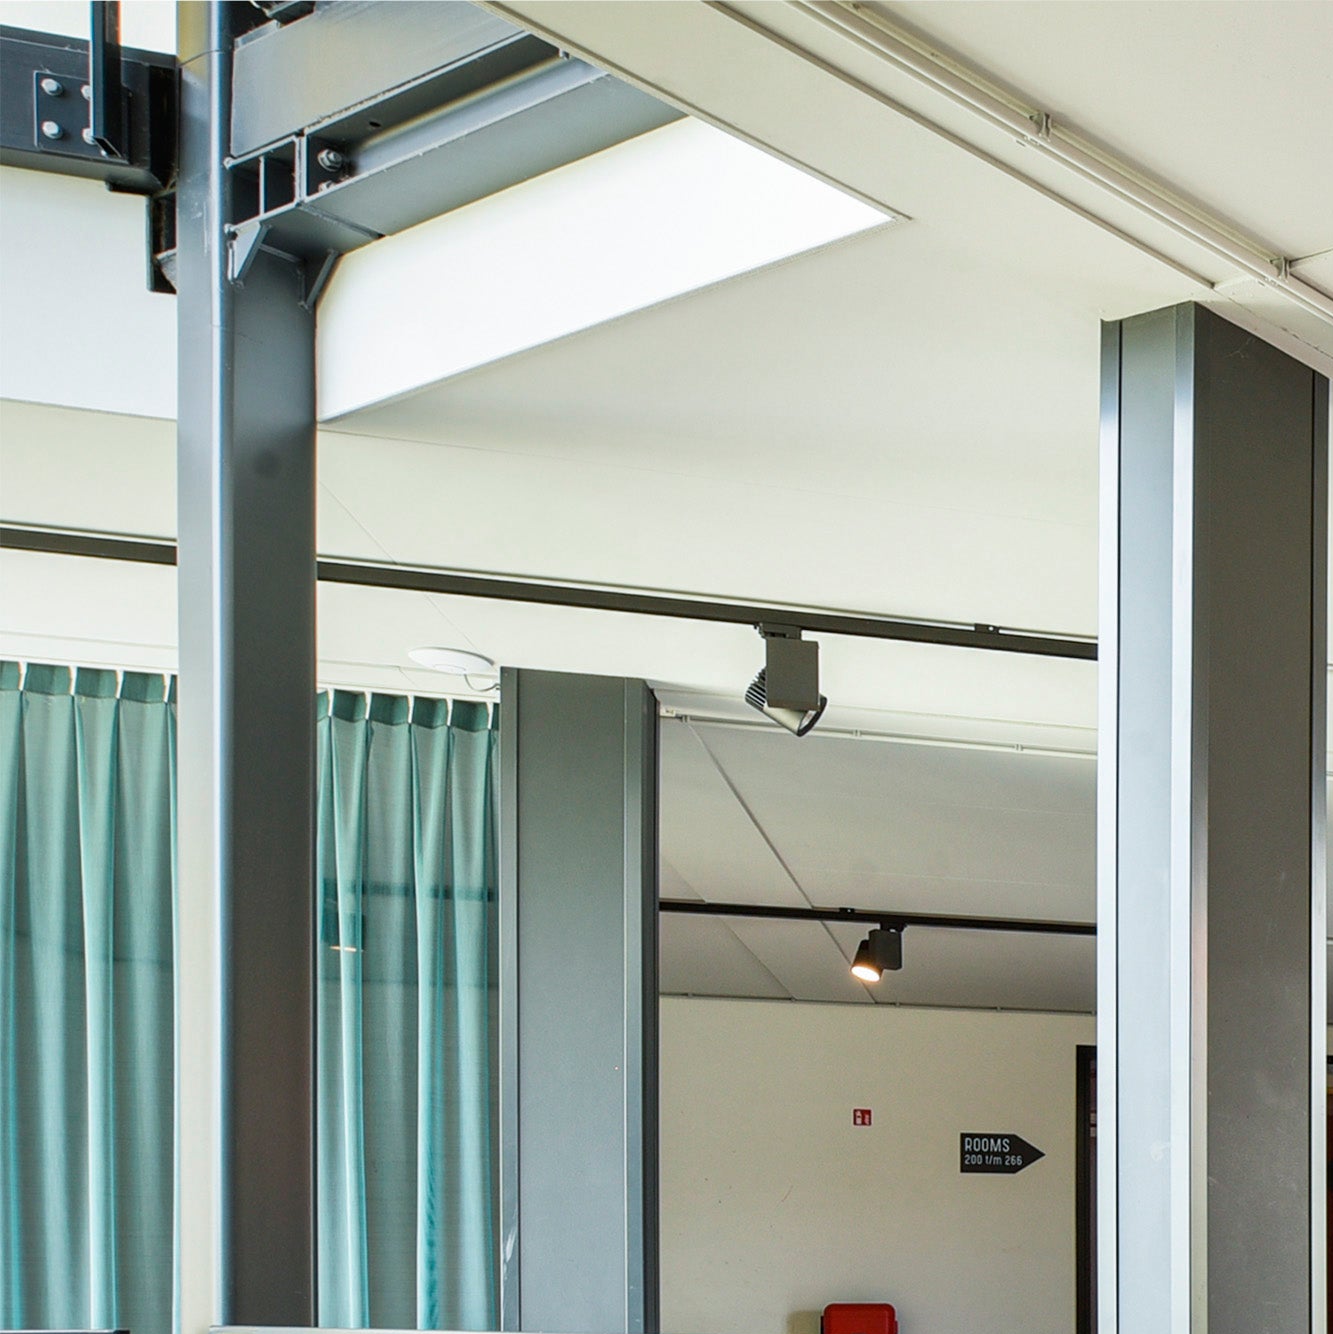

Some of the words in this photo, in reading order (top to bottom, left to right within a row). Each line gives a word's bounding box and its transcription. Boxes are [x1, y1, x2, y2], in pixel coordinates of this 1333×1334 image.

[964, 1137, 1010, 1152] ROOMS
[964, 1154, 983, 1164] 200
[985, 1155, 1003, 1165] t/m
[1004, 1155, 1023, 1165] 266
